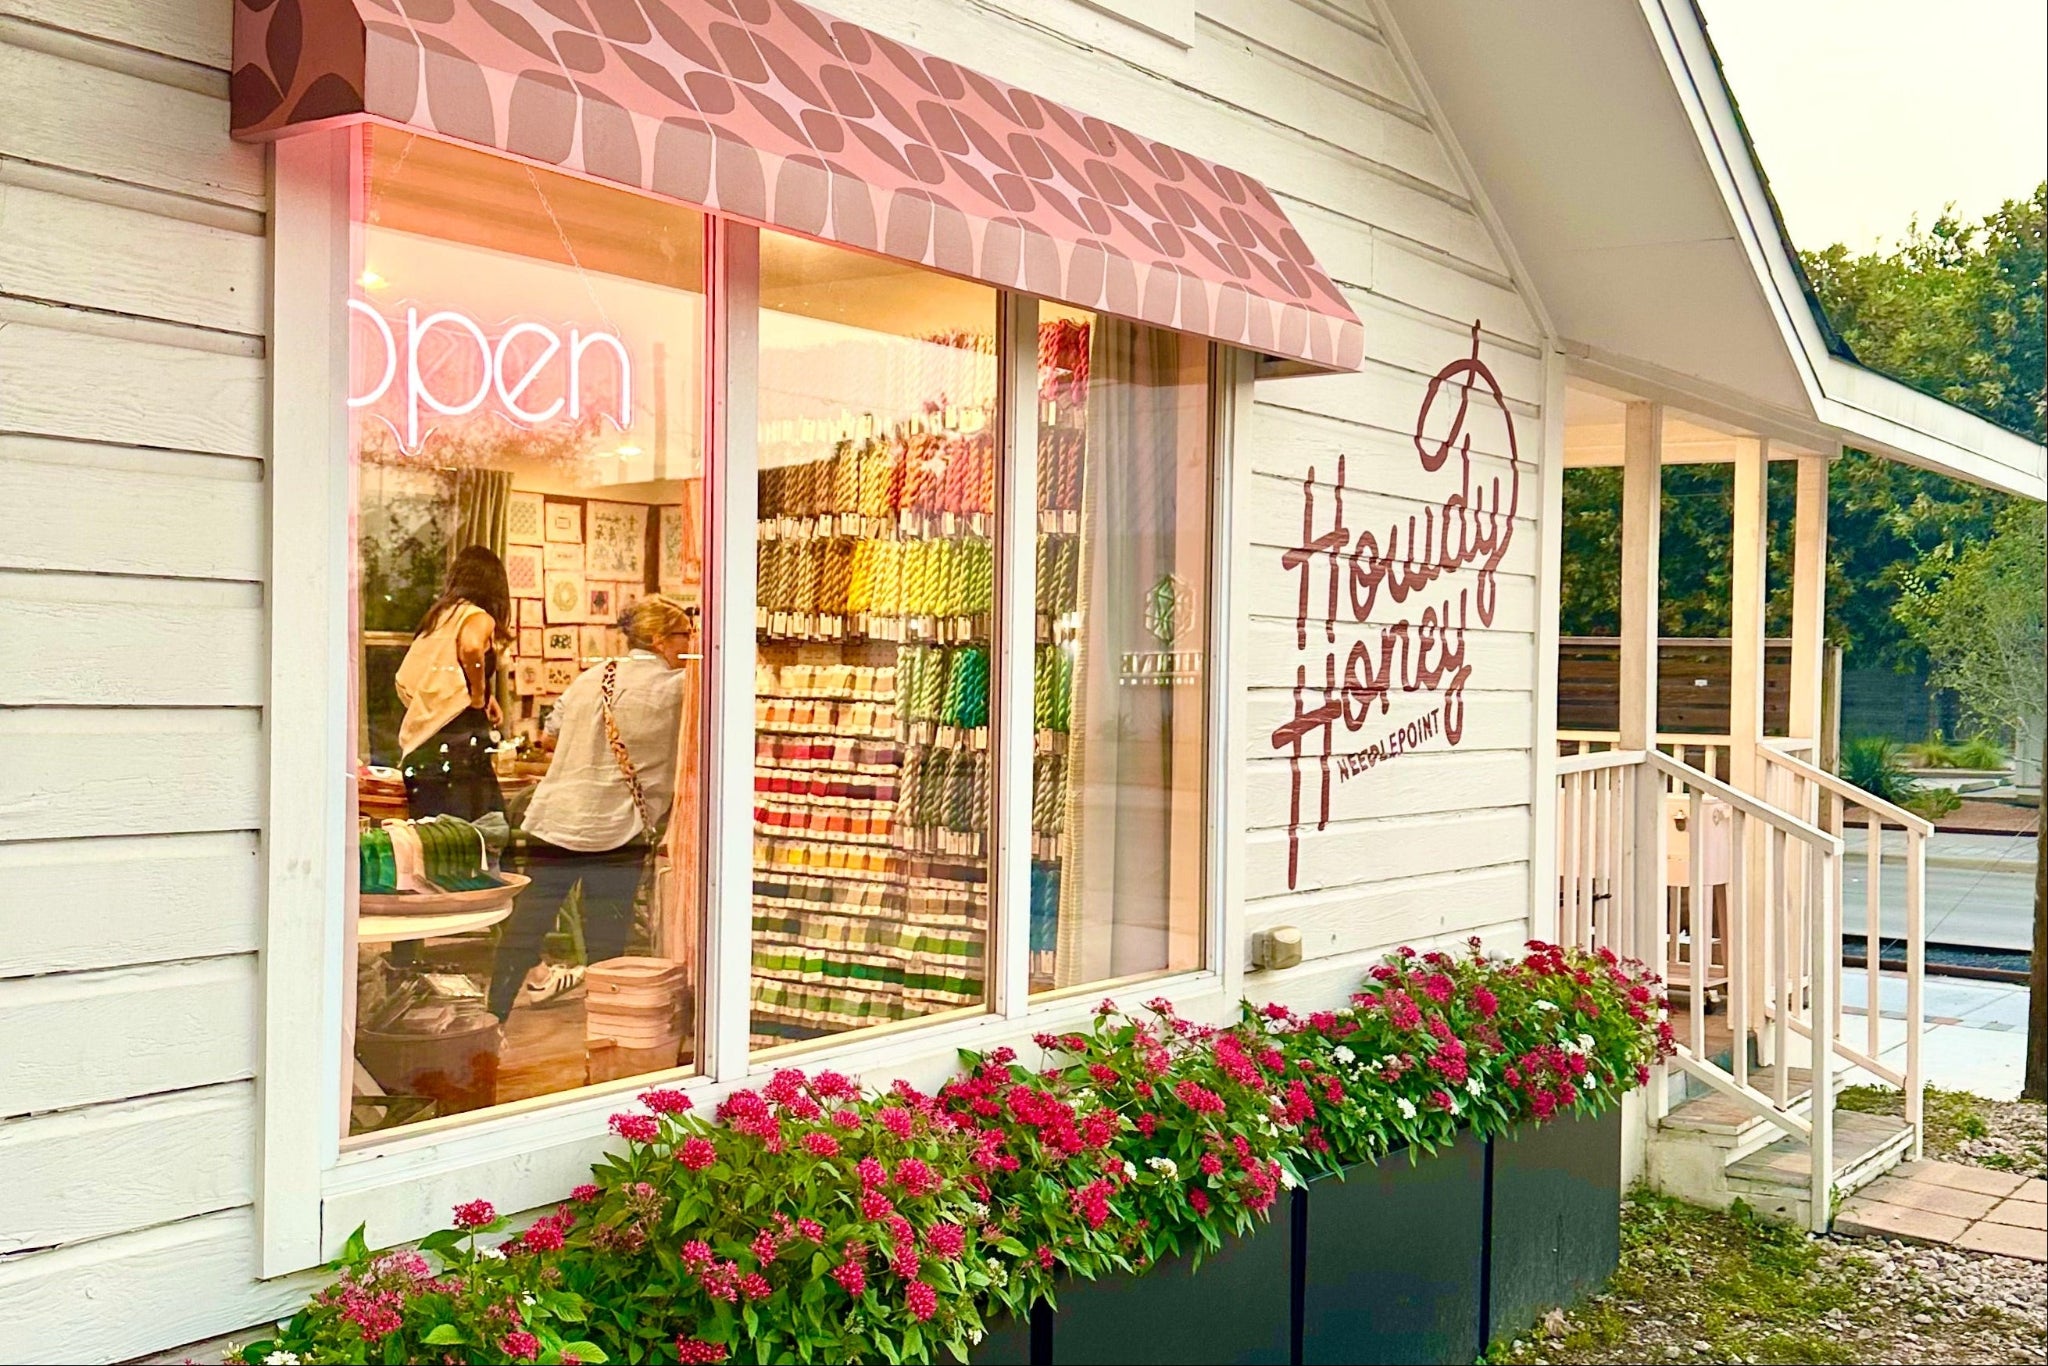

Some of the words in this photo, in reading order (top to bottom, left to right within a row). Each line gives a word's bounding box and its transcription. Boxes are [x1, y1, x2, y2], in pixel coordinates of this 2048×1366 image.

[1281, 319, 1519, 650] Howdy
[1271, 588, 1472, 890] Honey
[1336, 707, 1441, 784] NEEDLEPOINT
